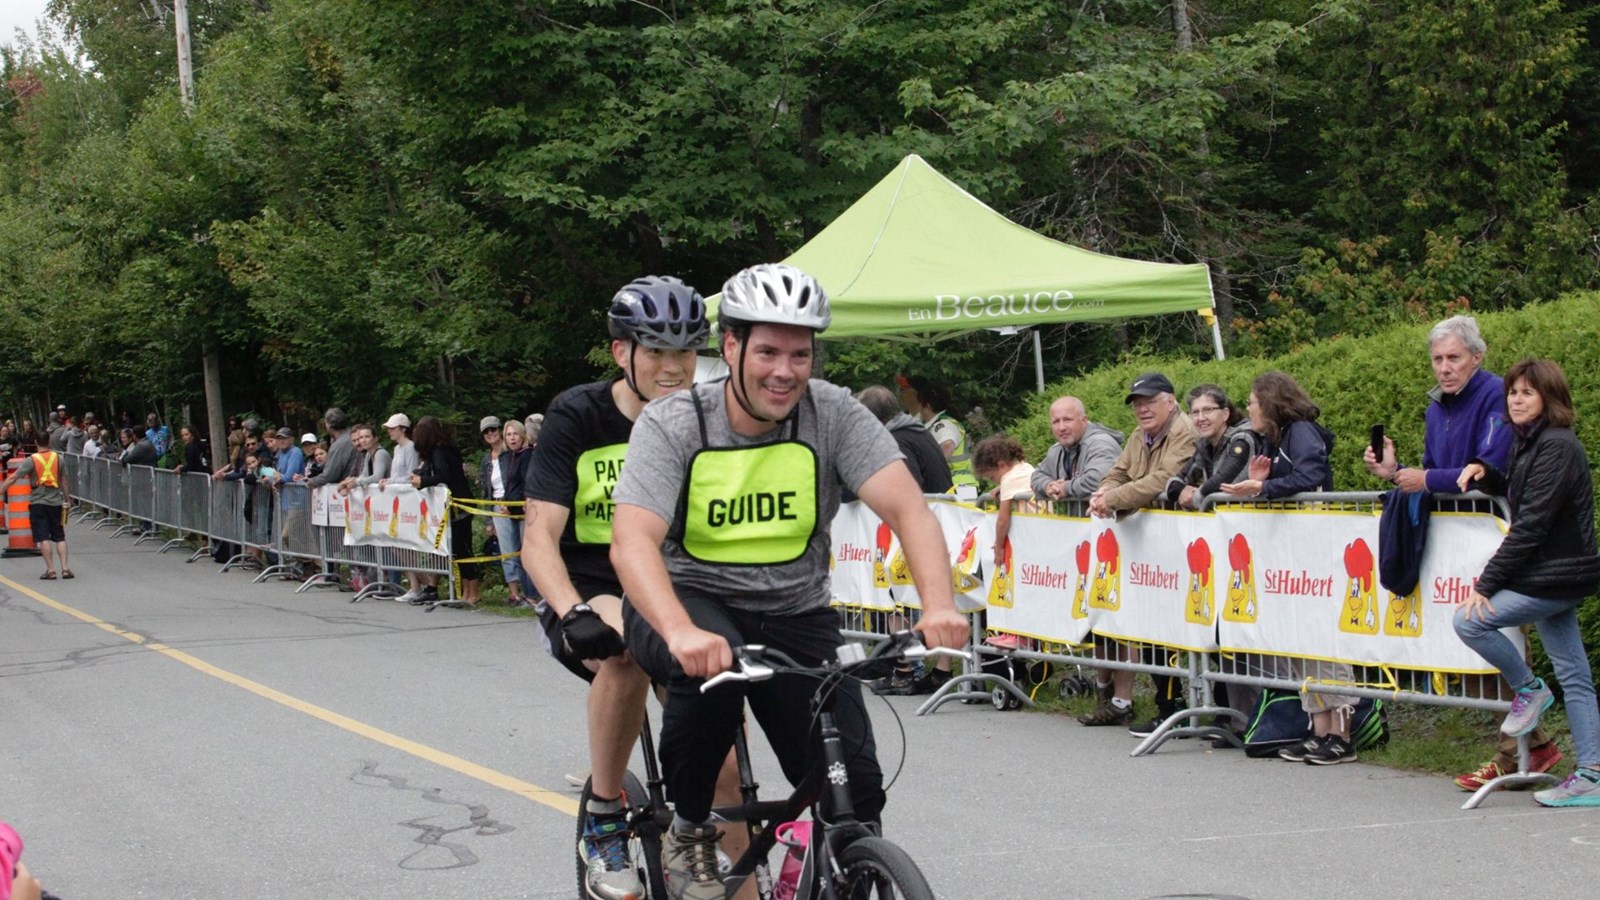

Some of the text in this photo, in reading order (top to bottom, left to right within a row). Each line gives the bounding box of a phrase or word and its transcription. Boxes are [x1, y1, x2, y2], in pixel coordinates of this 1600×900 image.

[908, 307, 931, 321] En
[934, 289, 1073, 321] Beauce
[707, 491, 798, 528] GUIDE
[1021, 563, 1067, 590] StHubert
[1130, 561, 1178, 590] StHubert
[1264, 568, 1333, 597] StHubert
